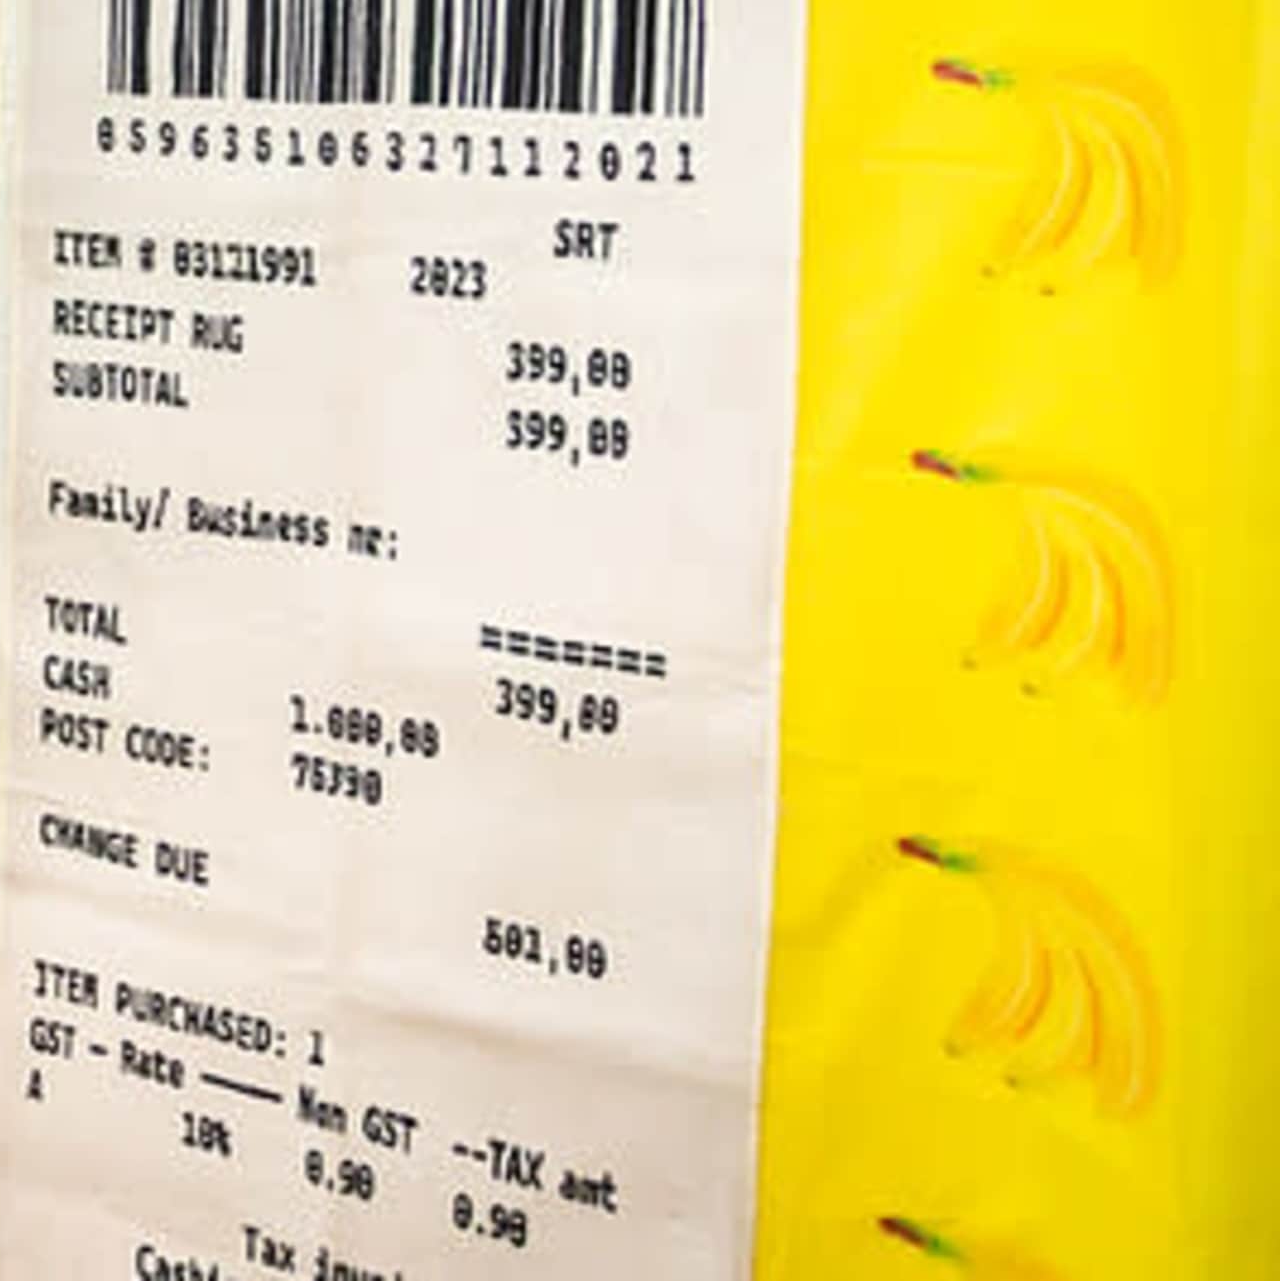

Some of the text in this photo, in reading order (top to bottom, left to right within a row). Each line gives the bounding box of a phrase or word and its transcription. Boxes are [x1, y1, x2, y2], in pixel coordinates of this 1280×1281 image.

[53, 230, 122, 270] ITEM
[410, 255, 487, 301] 2023
[553, 218, 620, 261] SRT
[52, 298, 175, 344] RECEIPT
[191, 312, 244, 354] RUG
[52, 360, 189, 409] SUBTOTAL
[48, 480, 171, 533] Family/
[186, 496, 330, 548] Business
[44, 595, 127, 646] TOTAL
[42, 654, 111, 700] CASH
[40, 706, 111, 754] POST
[124, 724, 210, 772] CODE:
[38, 813, 139, 869] CHANGE
[154, 841, 209, 887] DUE
[34, 959, 325, 1067] ITEM PURCHASED: 1
[27, 1069, 44, 1101] A
[28, 1017, 76, 1059] GST
[121, 1039, 185, 1090] Rate
[298, 1084, 348, 1135] Non
[361, 1105, 420, 1154] GST
[558, 1170, 617, 1214] amt
[243, 1224, 295, 1273] Tax
